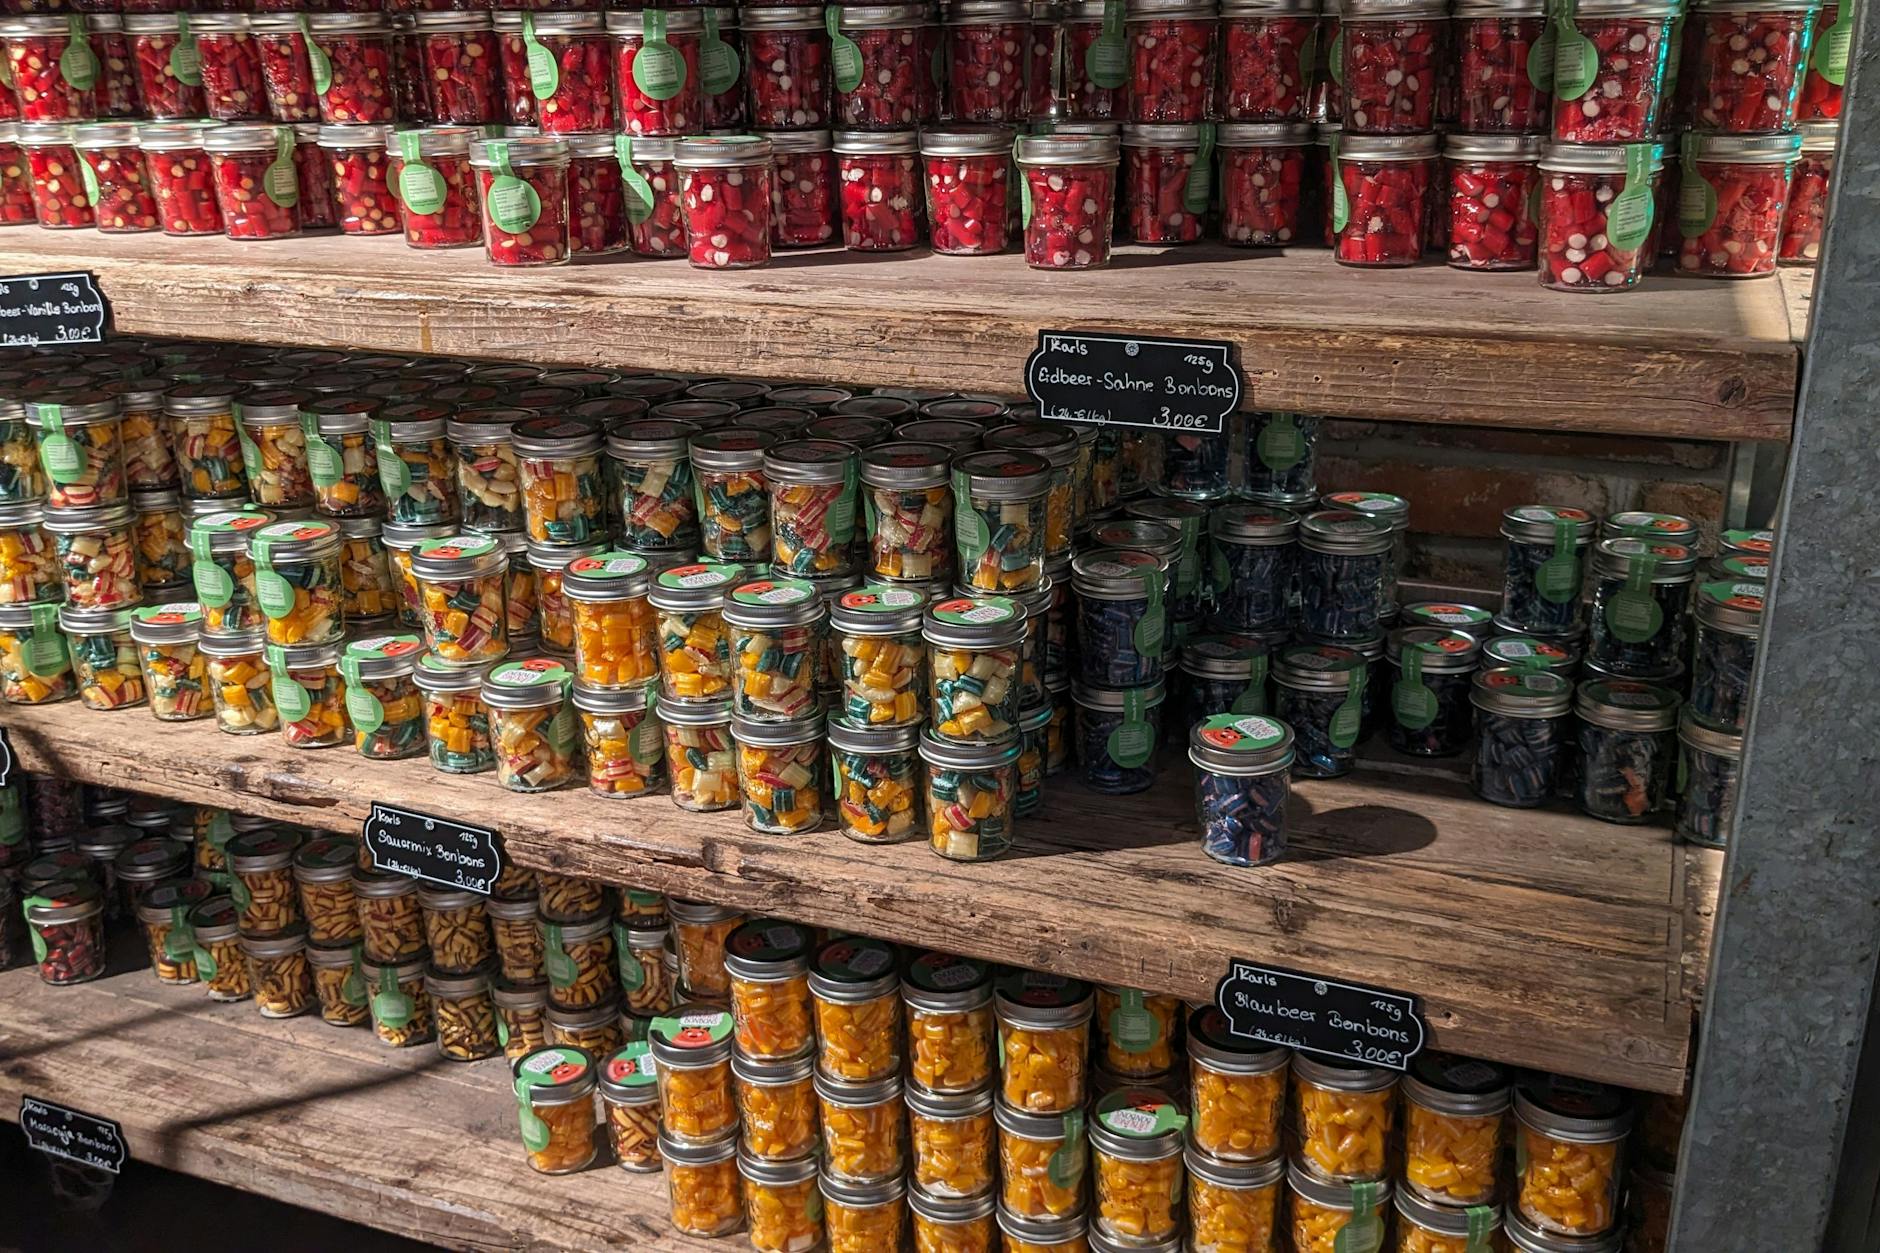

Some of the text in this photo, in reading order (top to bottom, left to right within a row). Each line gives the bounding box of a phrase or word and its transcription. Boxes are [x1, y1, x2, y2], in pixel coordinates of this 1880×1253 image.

[1050, 338, 1089, 356] Karls
[1184, 354, 1214, 374] 125g
[1163, 375, 1233, 399] Bonbons
[1152, 406, 1209, 429] 3,00€
[377, 810, 401, 826] Karls
[378, 829, 486, 868] Sauermix Bonbons
[459, 832, 478, 849] 125g
[455, 869, 486, 890] 3,00€
[1238, 967, 1277, 986] Karls
[1234, 991, 1409, 1044] Blaubeer Bonbons
[1370, 1000, 1402, 1021] 125g
